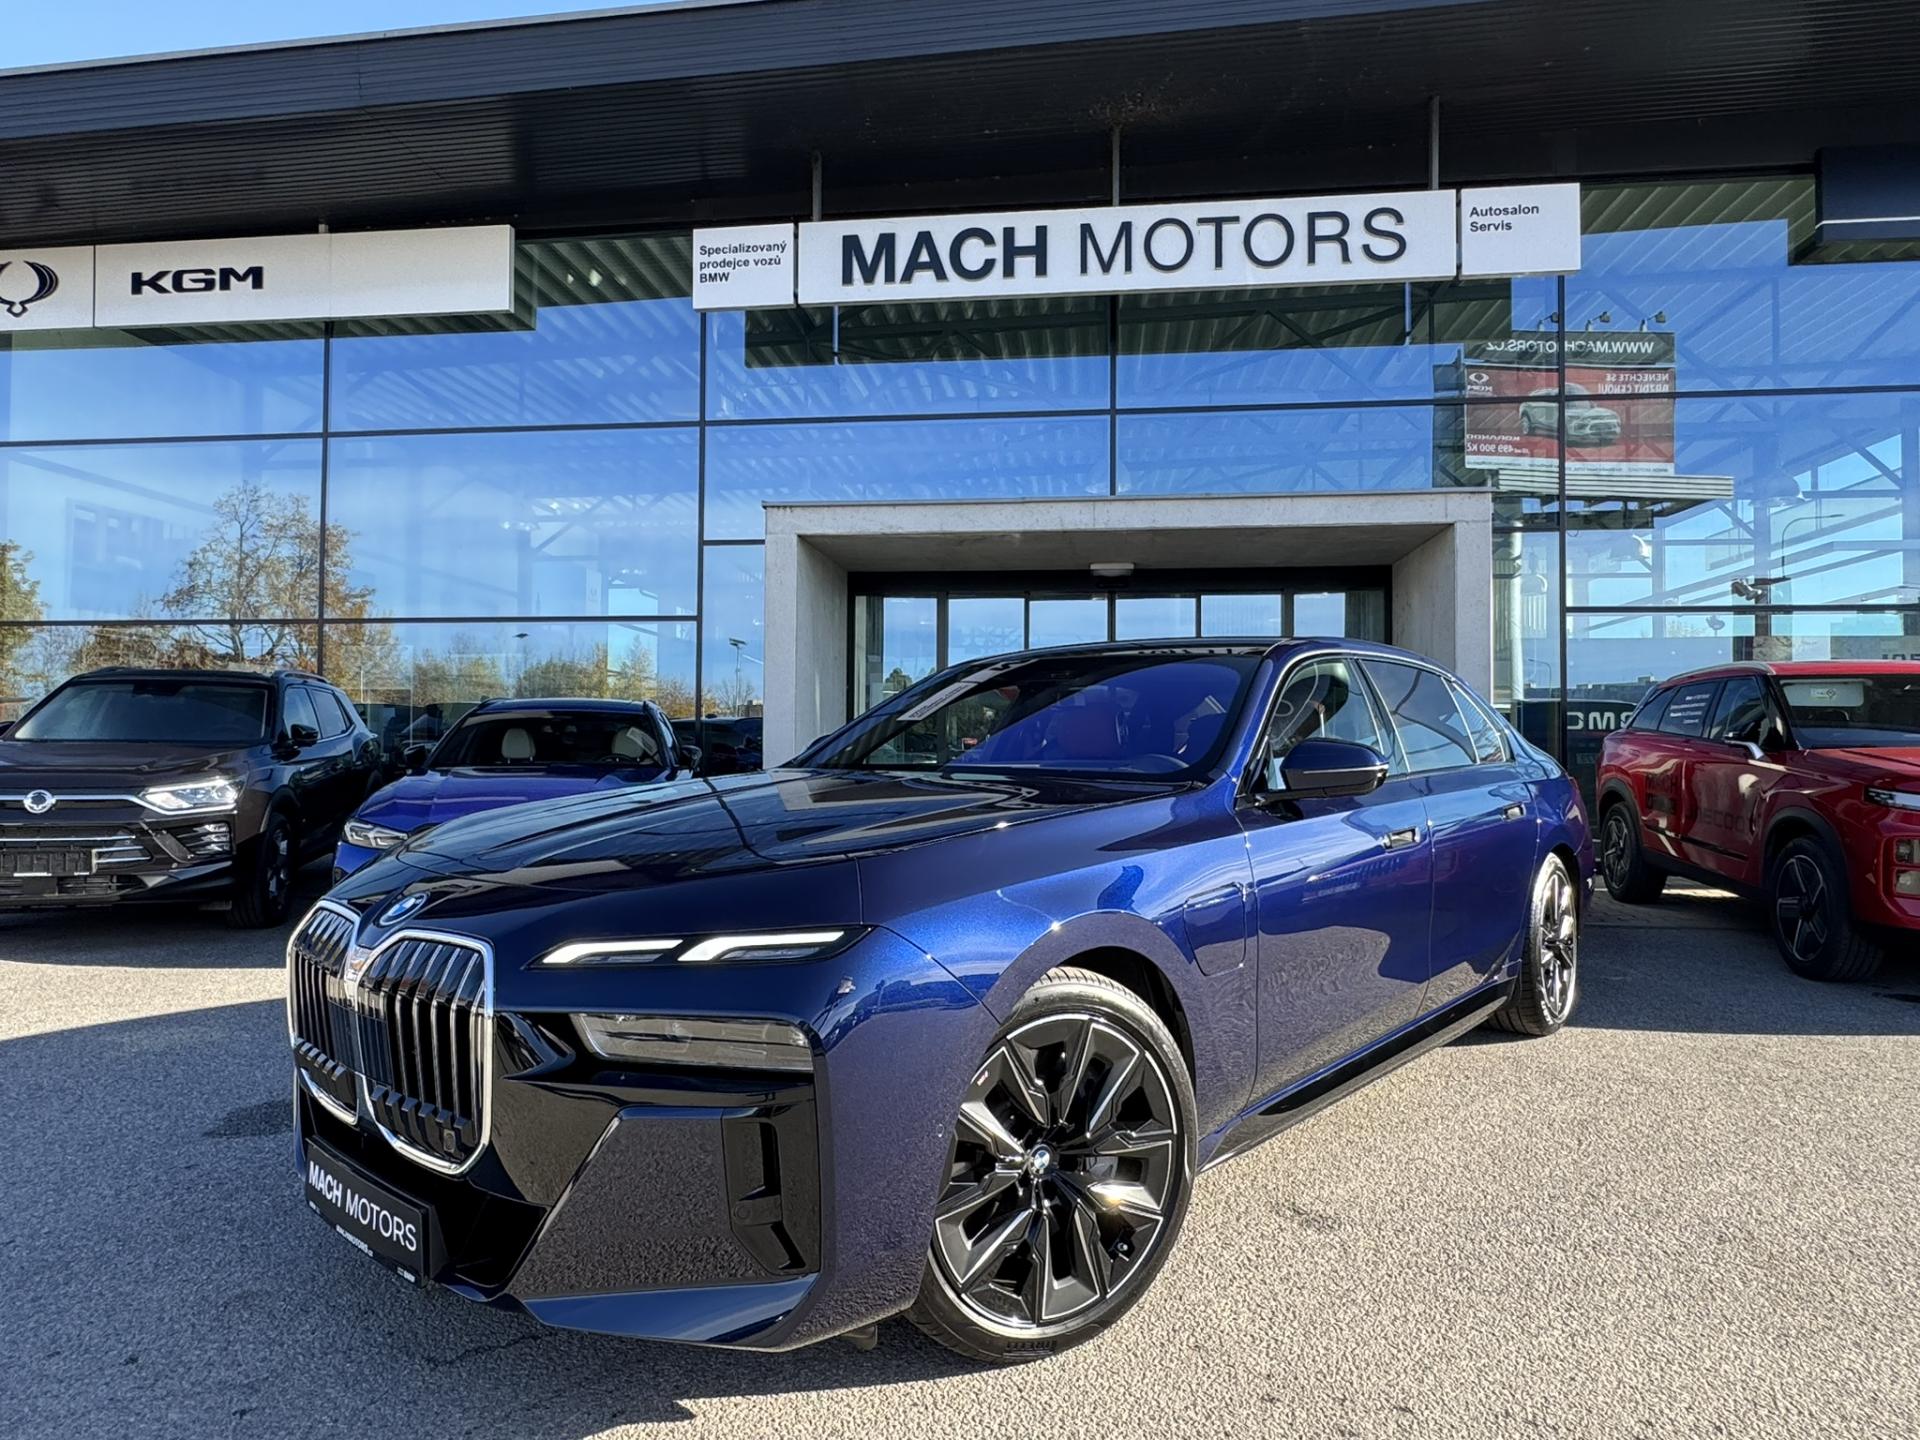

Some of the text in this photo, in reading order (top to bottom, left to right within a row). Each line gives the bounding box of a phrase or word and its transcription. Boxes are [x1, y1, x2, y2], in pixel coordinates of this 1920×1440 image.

[1469, 204, 1540, 218] Autosalon
[1469, 220, 1513, 233] Servis
[699, 240, 787, 257] Specializovaný
[841, 207, 1407, 286] MACH MOTORS
[699, 255, 781, 272] prodejce vozů
[130, 265, 264, 296] KGM
[699, 272, 730, 283] BMW
[308, 1160, 418, 1252] MACH MOTORS
